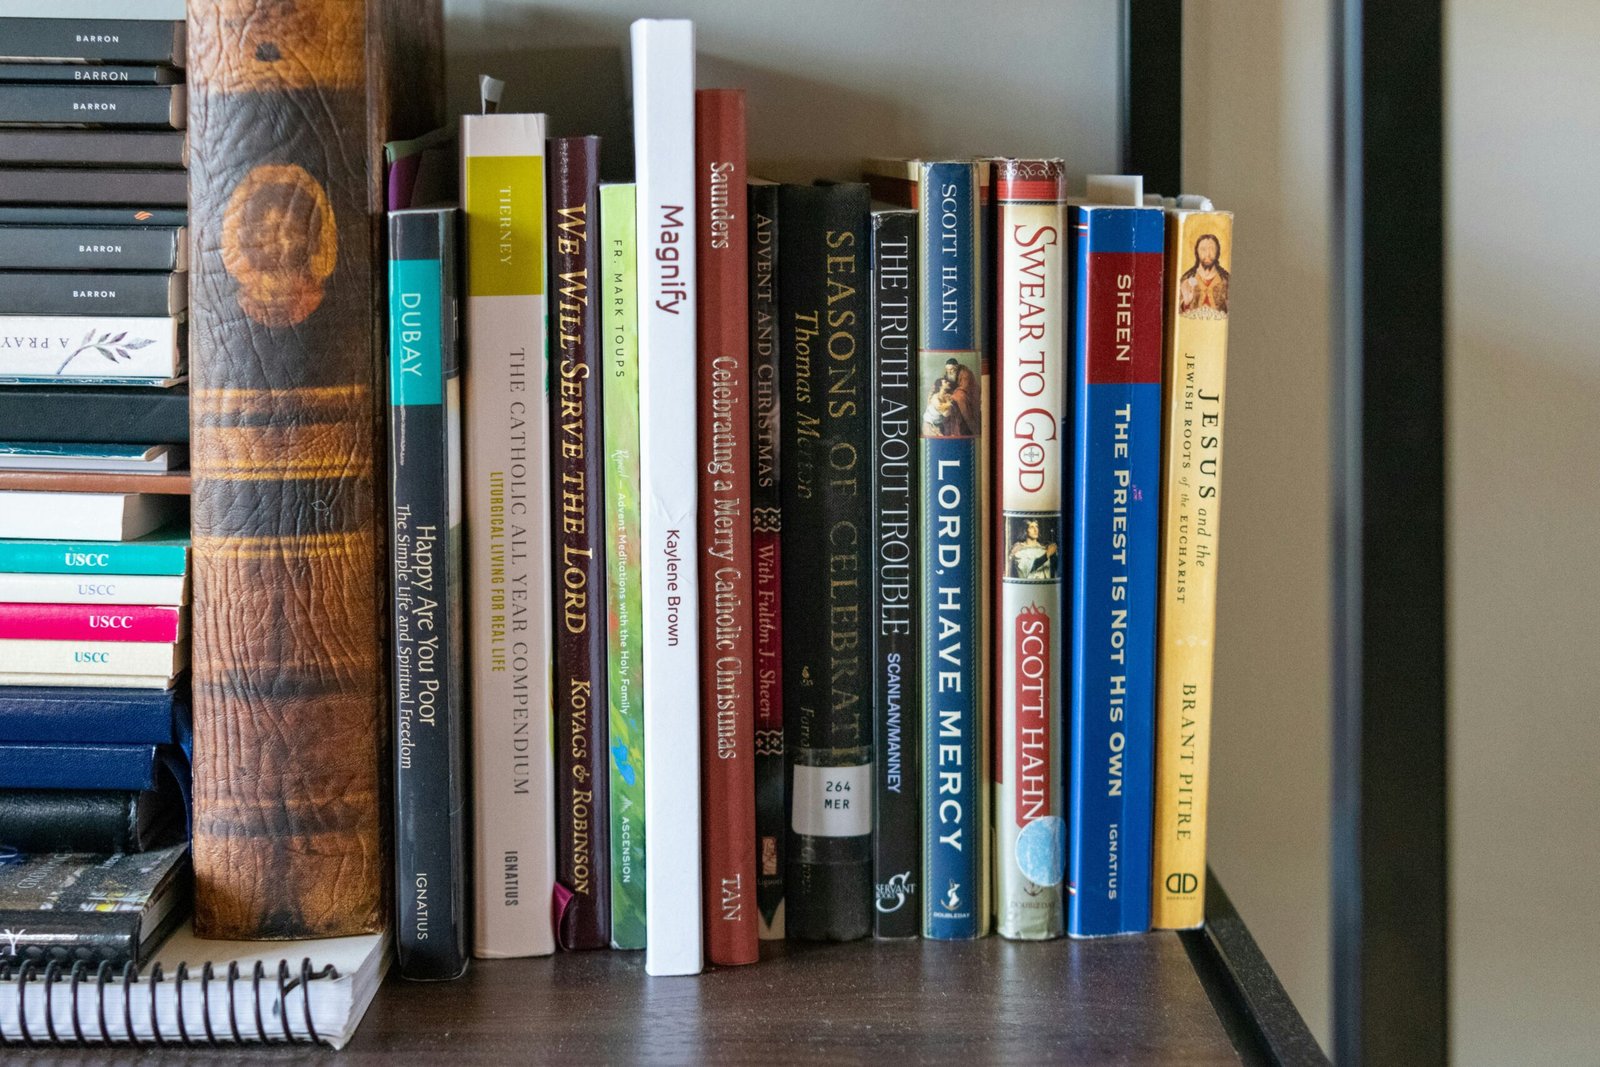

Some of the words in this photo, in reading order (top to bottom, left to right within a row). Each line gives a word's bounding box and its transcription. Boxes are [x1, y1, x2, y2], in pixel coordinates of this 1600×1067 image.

[76, 35, 119, 43] BARRON
[74, 71, 129, 81] BARRON
[73, 103, 116, 111] BARRON
[499, 186, 513, 266] TIERNEY
[557, 203, 587, 254] WE
[710, 161, 735, 249] Saunders
[941, 183, 958, 257] SCOTT
[79, 245, 122, 253] BARRON
[613, 240, 623, 264] FR.
[655, 205, 687, 315] Magnify
[757, 214, 774, 302] ADVENT
[880, 236, 908, 290] THE
[558, 268, 588, 350] WILL
[614, 273, 624, 316] MARK
[942, 265, 958, 334] HAHN
[1014, 224, 1058, 343] SWEAR
[59, 338, 69, 349] A
[401, 293, 422, 376] DUBAY
[757, 312, 773, 356] AND
[826, 230, 857, 419] SEASONS
[880, 296, 909, 389] TRUTH
[1115, 274, 1132, 361] SHEEN
[510, 347, 525, 393] THE
[615, 325, 625, 378] TOUPS
[795, 310, 820, 403] Thomas
[1018, 351, 1046, 398] TO
[1184, 353, 1196, 410] JEWISH
[560, 359, 590, 460] SERVE
[707, 356, 739, 475] Celebrating
[758, 364, 774, 488] CHRISTMAS
[1114, 403, 1131, 458] THE
[510, 401, 527, 515] CATHOLIC
[829, 442, 857, 497] OF
[880, 395, 909, 497] ABOUT
[1014, 407, 1058, 493] GOD
[1182, 419, 1193, 469] ROOTS
[1197, 388, 1220, 499] JESUS
[490, 471, 504, 540] LITURGICAL
[563, 471, 585, 534] THE
[713, 480, 734, 492] a
[1179, 476, 1190, 487] of
[1180, 493, 1190, 507] the
[396, 504, 410, 531] The
[617, 493, 627, 531] Advent
[708, 498, 740, 562] Merry
[935, 460, 961, 575] LORD,
[1112, 469, 1131, 565] PRIEST
[1196, 508, 1211, 536] and
[65, 553, 109, 566] USCC
[395, 534, 411, 581] Simple
[411, 525, 438, 591] Happy
[491, 544, 505, 584] LIVING
[511, 527, 527, 565] ALL
[618, 534, 628, 599] Meditations
[663, 530, 681, 591] Kaylene
[758, 544, 775, 584] With
[880, 503, 910, 636] TROUBLE
[1176, 515, 1189, 604] EUCHARIST
[1195, 544, 1211, 567] the
[78, 584, 116, 596] USCC
[398, 586, 412, 611] Life
[412, 596, 438, 630] Are
[491, 589, 505, 611] FOR
[512, 574, 528, 632] YEAR
[564, 544, 593, 634] LORD
[619, 602, 629, 626] with
[714, 567, 741, 650] Catholic
[1111, 576, 1127, 601] IS
[89, 615, 133, 629] USCC
[399, 615, 413, 641] and
[491, 615, 505, 644] REAL
[620, 629, 629, 647] the
[667, 597, 681, 647] Brown
[758, 590, 776, 643] Fulton
[939, 587, 961, 693] HAVE
[1110, 609, 1127, 665] NOT
[75, 651, 109, 663] USCC
[398, 646, 414, 703] Spiritual
[418, 636, 439, 672] You
[491, 649, 506, 672] LIFE
[618, 651, 629, 675] Holy
[757, 648, 775, 663] J.
[1020, 620, 1044, 718] SCOTT
[418, 679, 440, 726] Poor
[512, 642, 529, 796] COMPENDIUM
[571, 678, 591, 758] KOVACS
[618, 679, 630, 715] Family
[715, 656, 743, 759] Christmas
[759, 670, 777, 718] Sheen
[1108, 675, 1126, 723] HIS
[399, 709, 414, 769] Freedom
[885, 653, 901, 793] SCANLAN/MANNEY
[1180, 684, 1197, 765] BRANT
[573, 764, 588, 783] &
[826, 781, 851, 792] 264
[939, 710, 962, 852] MERCY
[1021, 727, 1045, 821] HAHN
[1108, 731, 1125, 797] OWN
[824, 800, 850, 809] MER
[1176, 774, 1193, 841] PITRE
[573, 789, 592, 895] ROBINSON
[621, 816, 631, 884] ASCENSION
[1108, 823, 1118, 900] IGNATIUS
[504, 851, 519, 906] IGNATIUS
[721, 874, 741, 922] TAN
[416, 873, 428, 940] IGNATIUS
